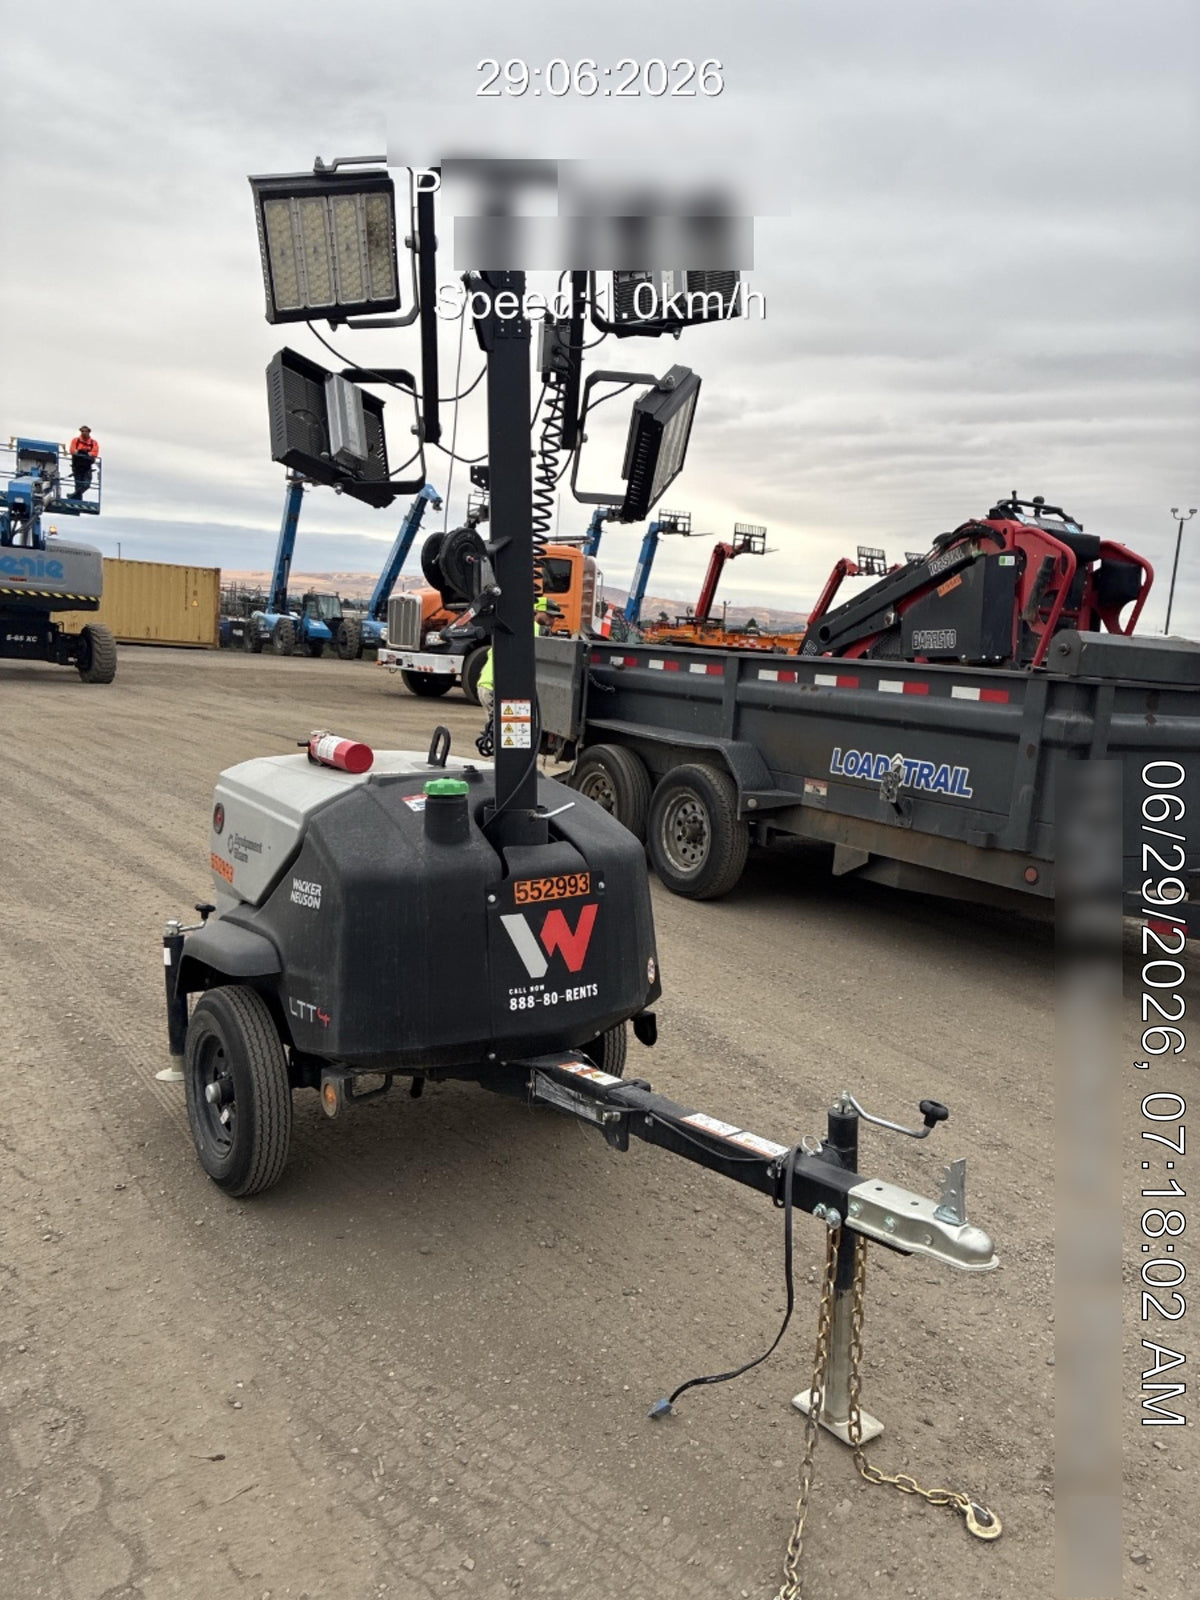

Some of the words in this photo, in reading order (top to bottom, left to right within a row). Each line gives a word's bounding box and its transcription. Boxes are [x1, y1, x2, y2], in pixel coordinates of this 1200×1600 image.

[0, 554, 64, 580] enie
[912, 629, 957, 650] BARRETO
[830, 748, 890, 782] LOAD
[902, 757, 973, 798] TRAIL
[292, 878, 322, 897] WACKER
[515, 873, 589, 903] 552993
[290, 890, 321, 910] NEUSON
[509, 983, 599, 1011] 888-80-RENTS
[529, 984, 545, 992] NOW
